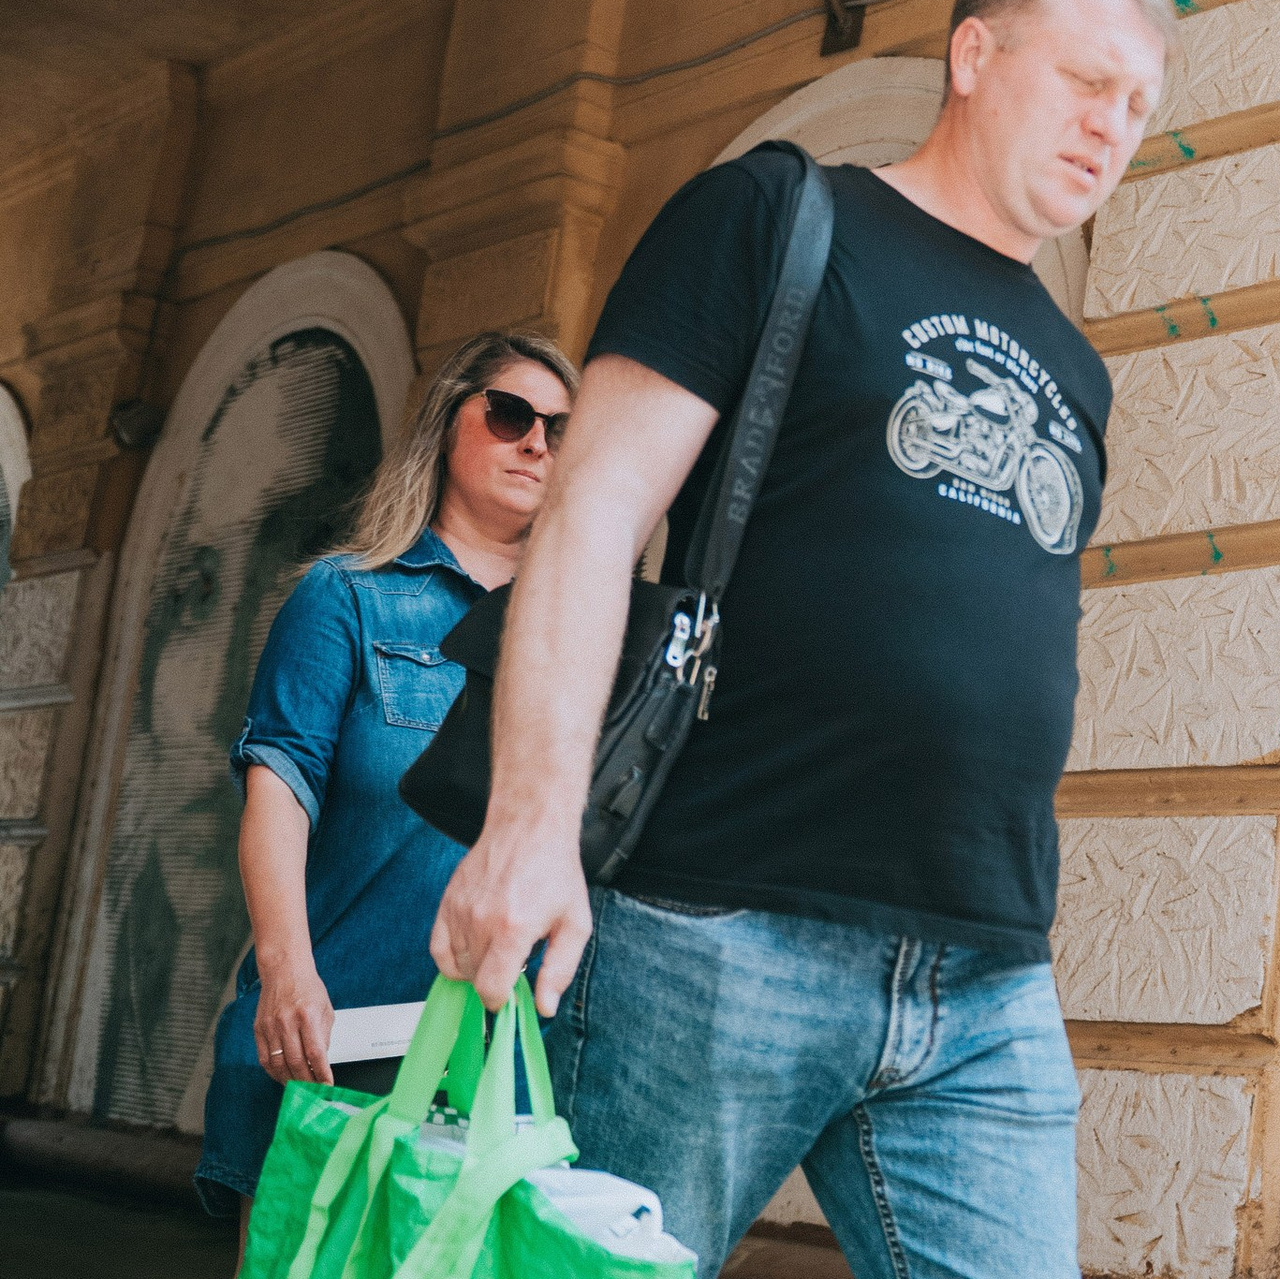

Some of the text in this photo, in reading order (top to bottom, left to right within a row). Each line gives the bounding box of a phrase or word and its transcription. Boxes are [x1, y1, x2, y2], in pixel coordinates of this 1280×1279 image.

[901, 314, 1078, 431] CUSTOM MOTORCYCLES
[937, 483, 1022, 525] CALIFORNIA
